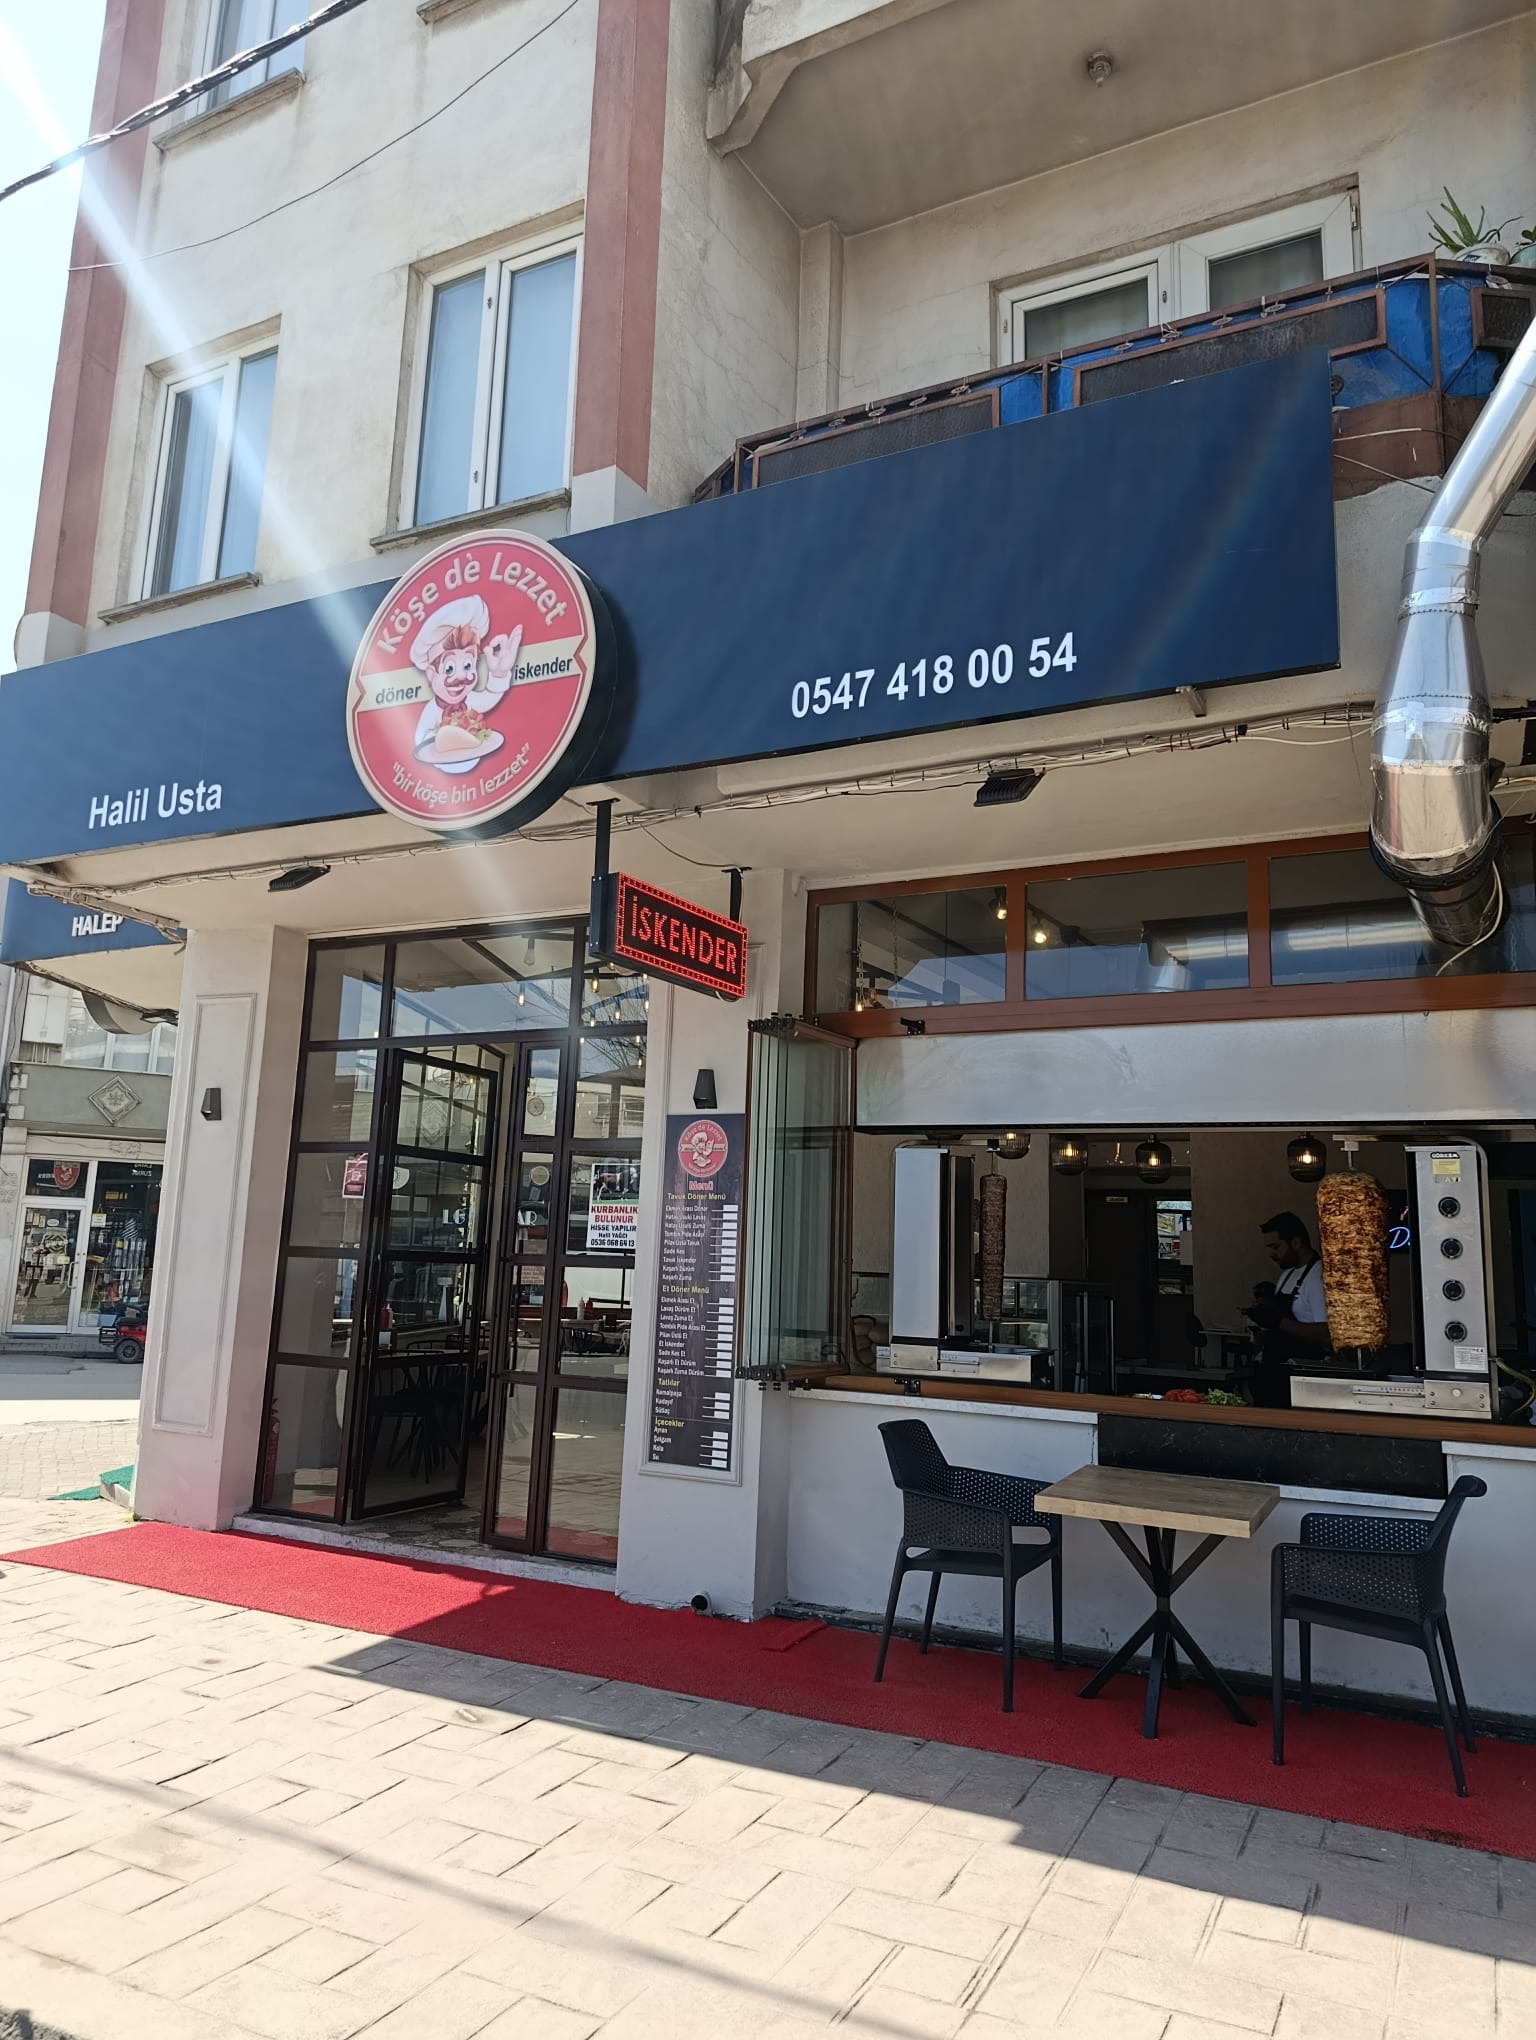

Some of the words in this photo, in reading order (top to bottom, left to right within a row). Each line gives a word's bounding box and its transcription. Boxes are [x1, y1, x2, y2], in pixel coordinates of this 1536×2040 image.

[377, 581, 440, 655] Köşe
[444, 553, 481, 591] dè
[488, 552, 568, 626] Lezzet
[514, 656, 573, 681] iskender
[790, 668, 875, 718] 0547
[887, 654, 954, 701] 418
[967, 644, 1014, 688] 00
[1028, 631, 1077, 678] 54
[375, 684, 421, 706] döner
[88, 787, 149, 829] Halil
[158, 779, 222, 818] Usta
[412, 780, 448, 809] köşe
[451, 784, 476, 806] bin
[71, 913, 124, 937] HALEP
[631, 896, 738, 975] İSKENDER
[591, 1206, 638, 1214] KURBANLIK
[595, 1215, 633, 1223] BULUNUR
[670, 1285, 690, 1293] Döner
[691, 1286, 709, 1294] Menü
[655, 1416, 684, 1427] İçecekler
